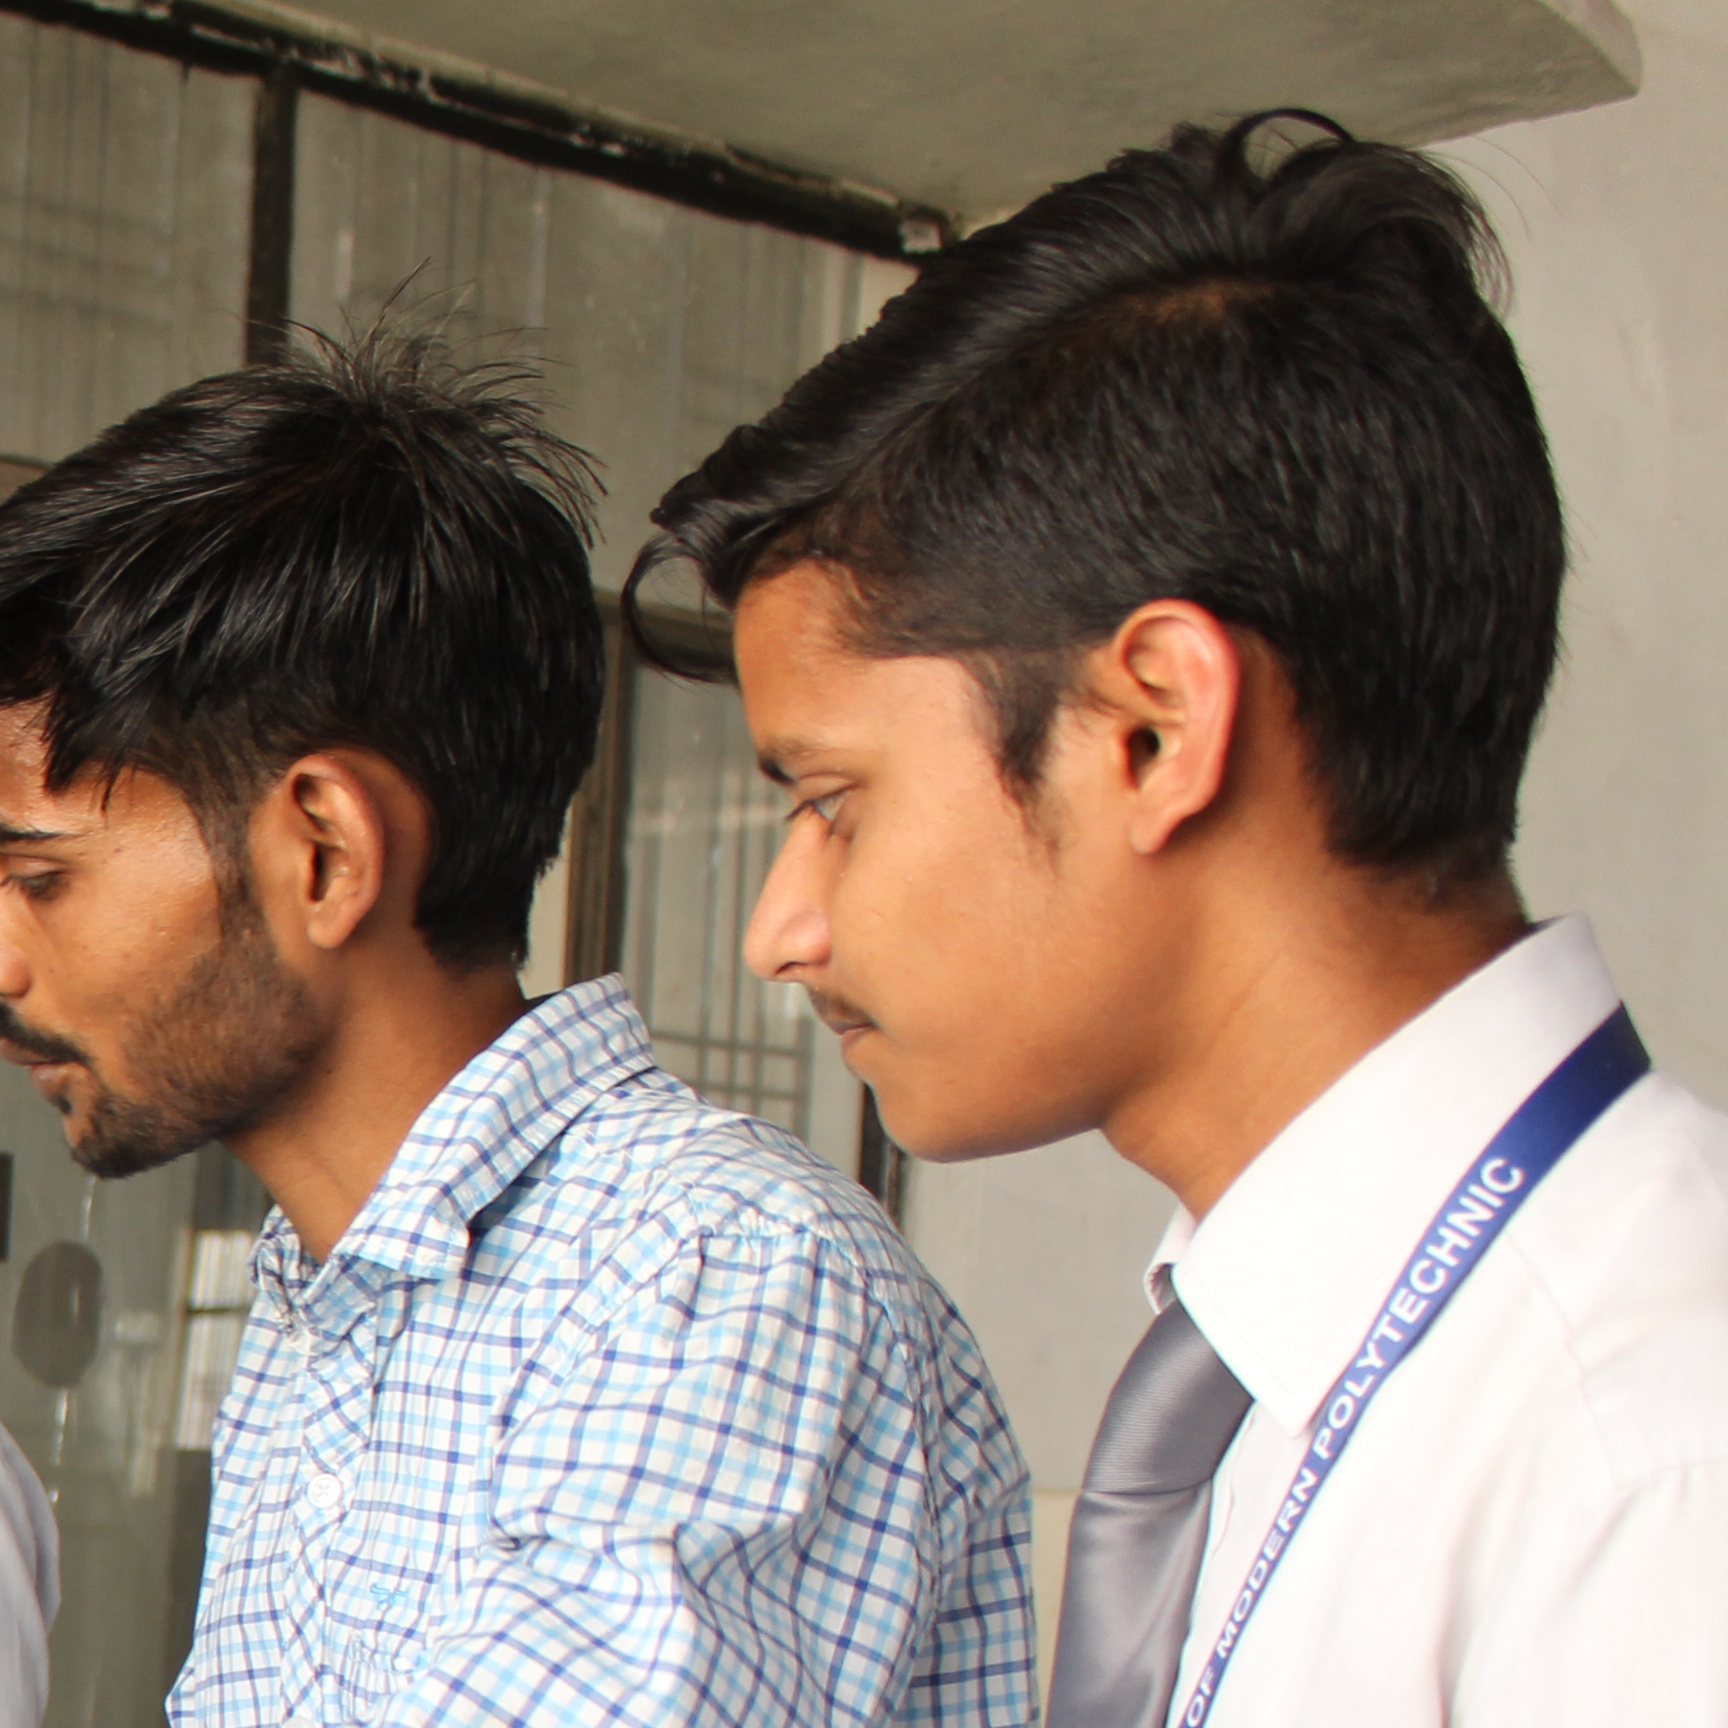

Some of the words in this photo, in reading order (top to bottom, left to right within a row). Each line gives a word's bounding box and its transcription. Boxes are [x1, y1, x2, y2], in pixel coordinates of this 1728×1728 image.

[1186, 1668, 1216, 1728] OF
[1216, 1467, 1319, 1659] MODERN
[1312, 1156, 1526, 1460] POLYTECHNIC
